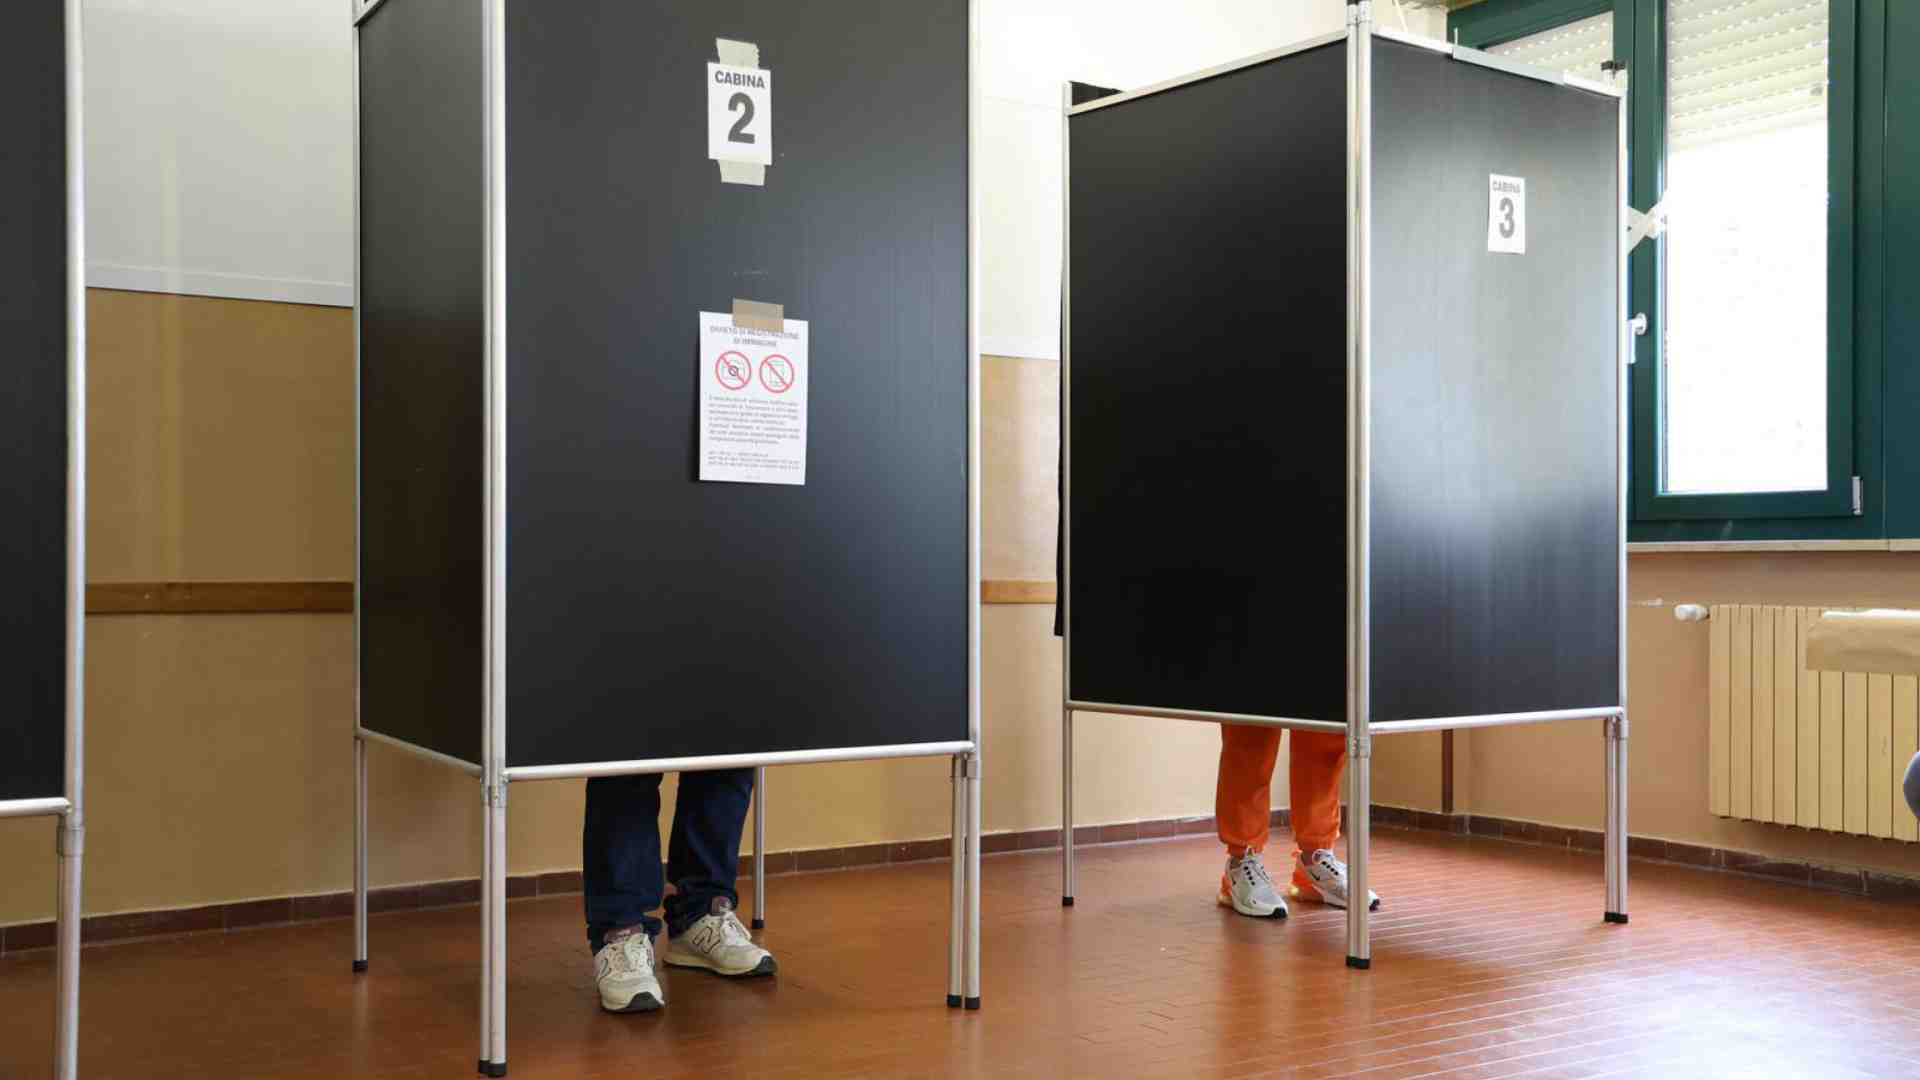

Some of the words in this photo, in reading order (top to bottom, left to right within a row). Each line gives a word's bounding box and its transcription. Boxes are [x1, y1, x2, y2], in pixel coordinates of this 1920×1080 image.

[714, 70, 765, 88] CABINA
[727, 92, 755, 144] 2
[1492, 180, 1521, 193] CABINA
[1499, 197, 1515, 239] 3
